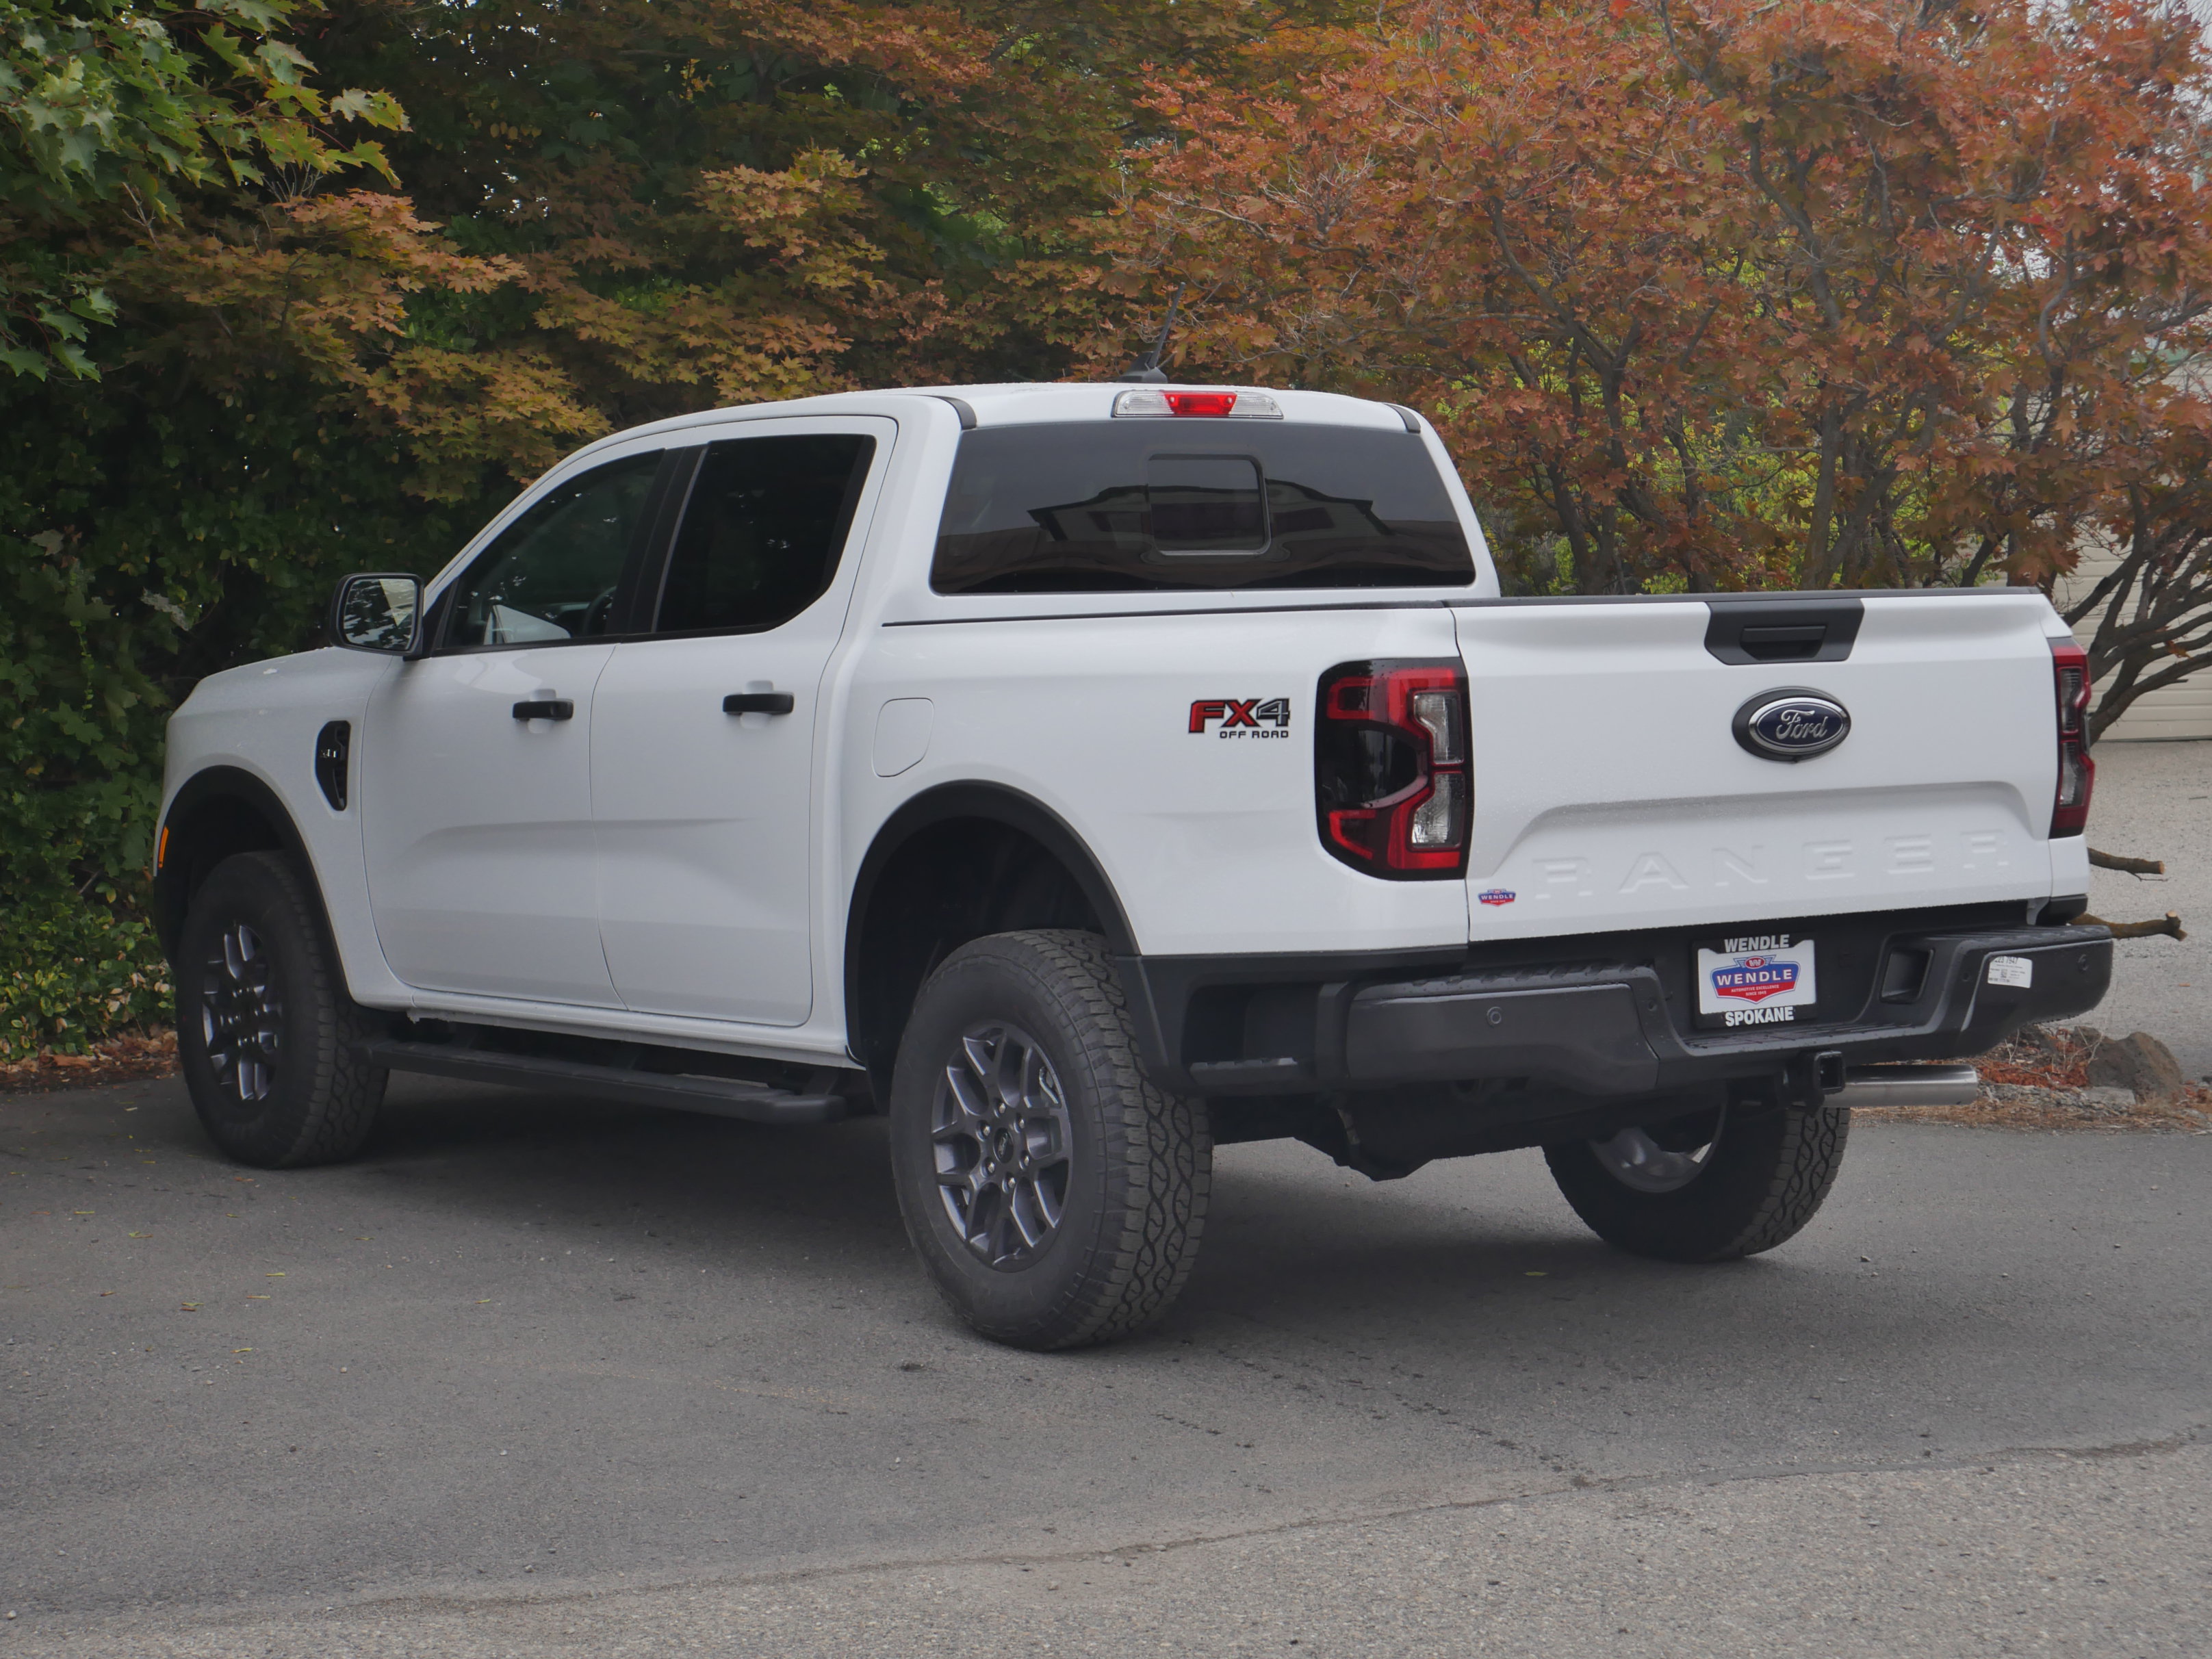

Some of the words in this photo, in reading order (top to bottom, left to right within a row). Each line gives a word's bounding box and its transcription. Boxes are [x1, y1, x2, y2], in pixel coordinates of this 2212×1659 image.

[1188, 698, 1291, 734] FX4
[1775, 709, 1829, 740] Ford
[1252, 730, 1289, 738] ROAD
[1532, 828, 2010, 900] RANGER
[1724, 934, 1790, 953] WENDLE
[1716, 969, 1792, 986] WENDLE
[1725, 1006, 1795, 1027] SPOKANE
